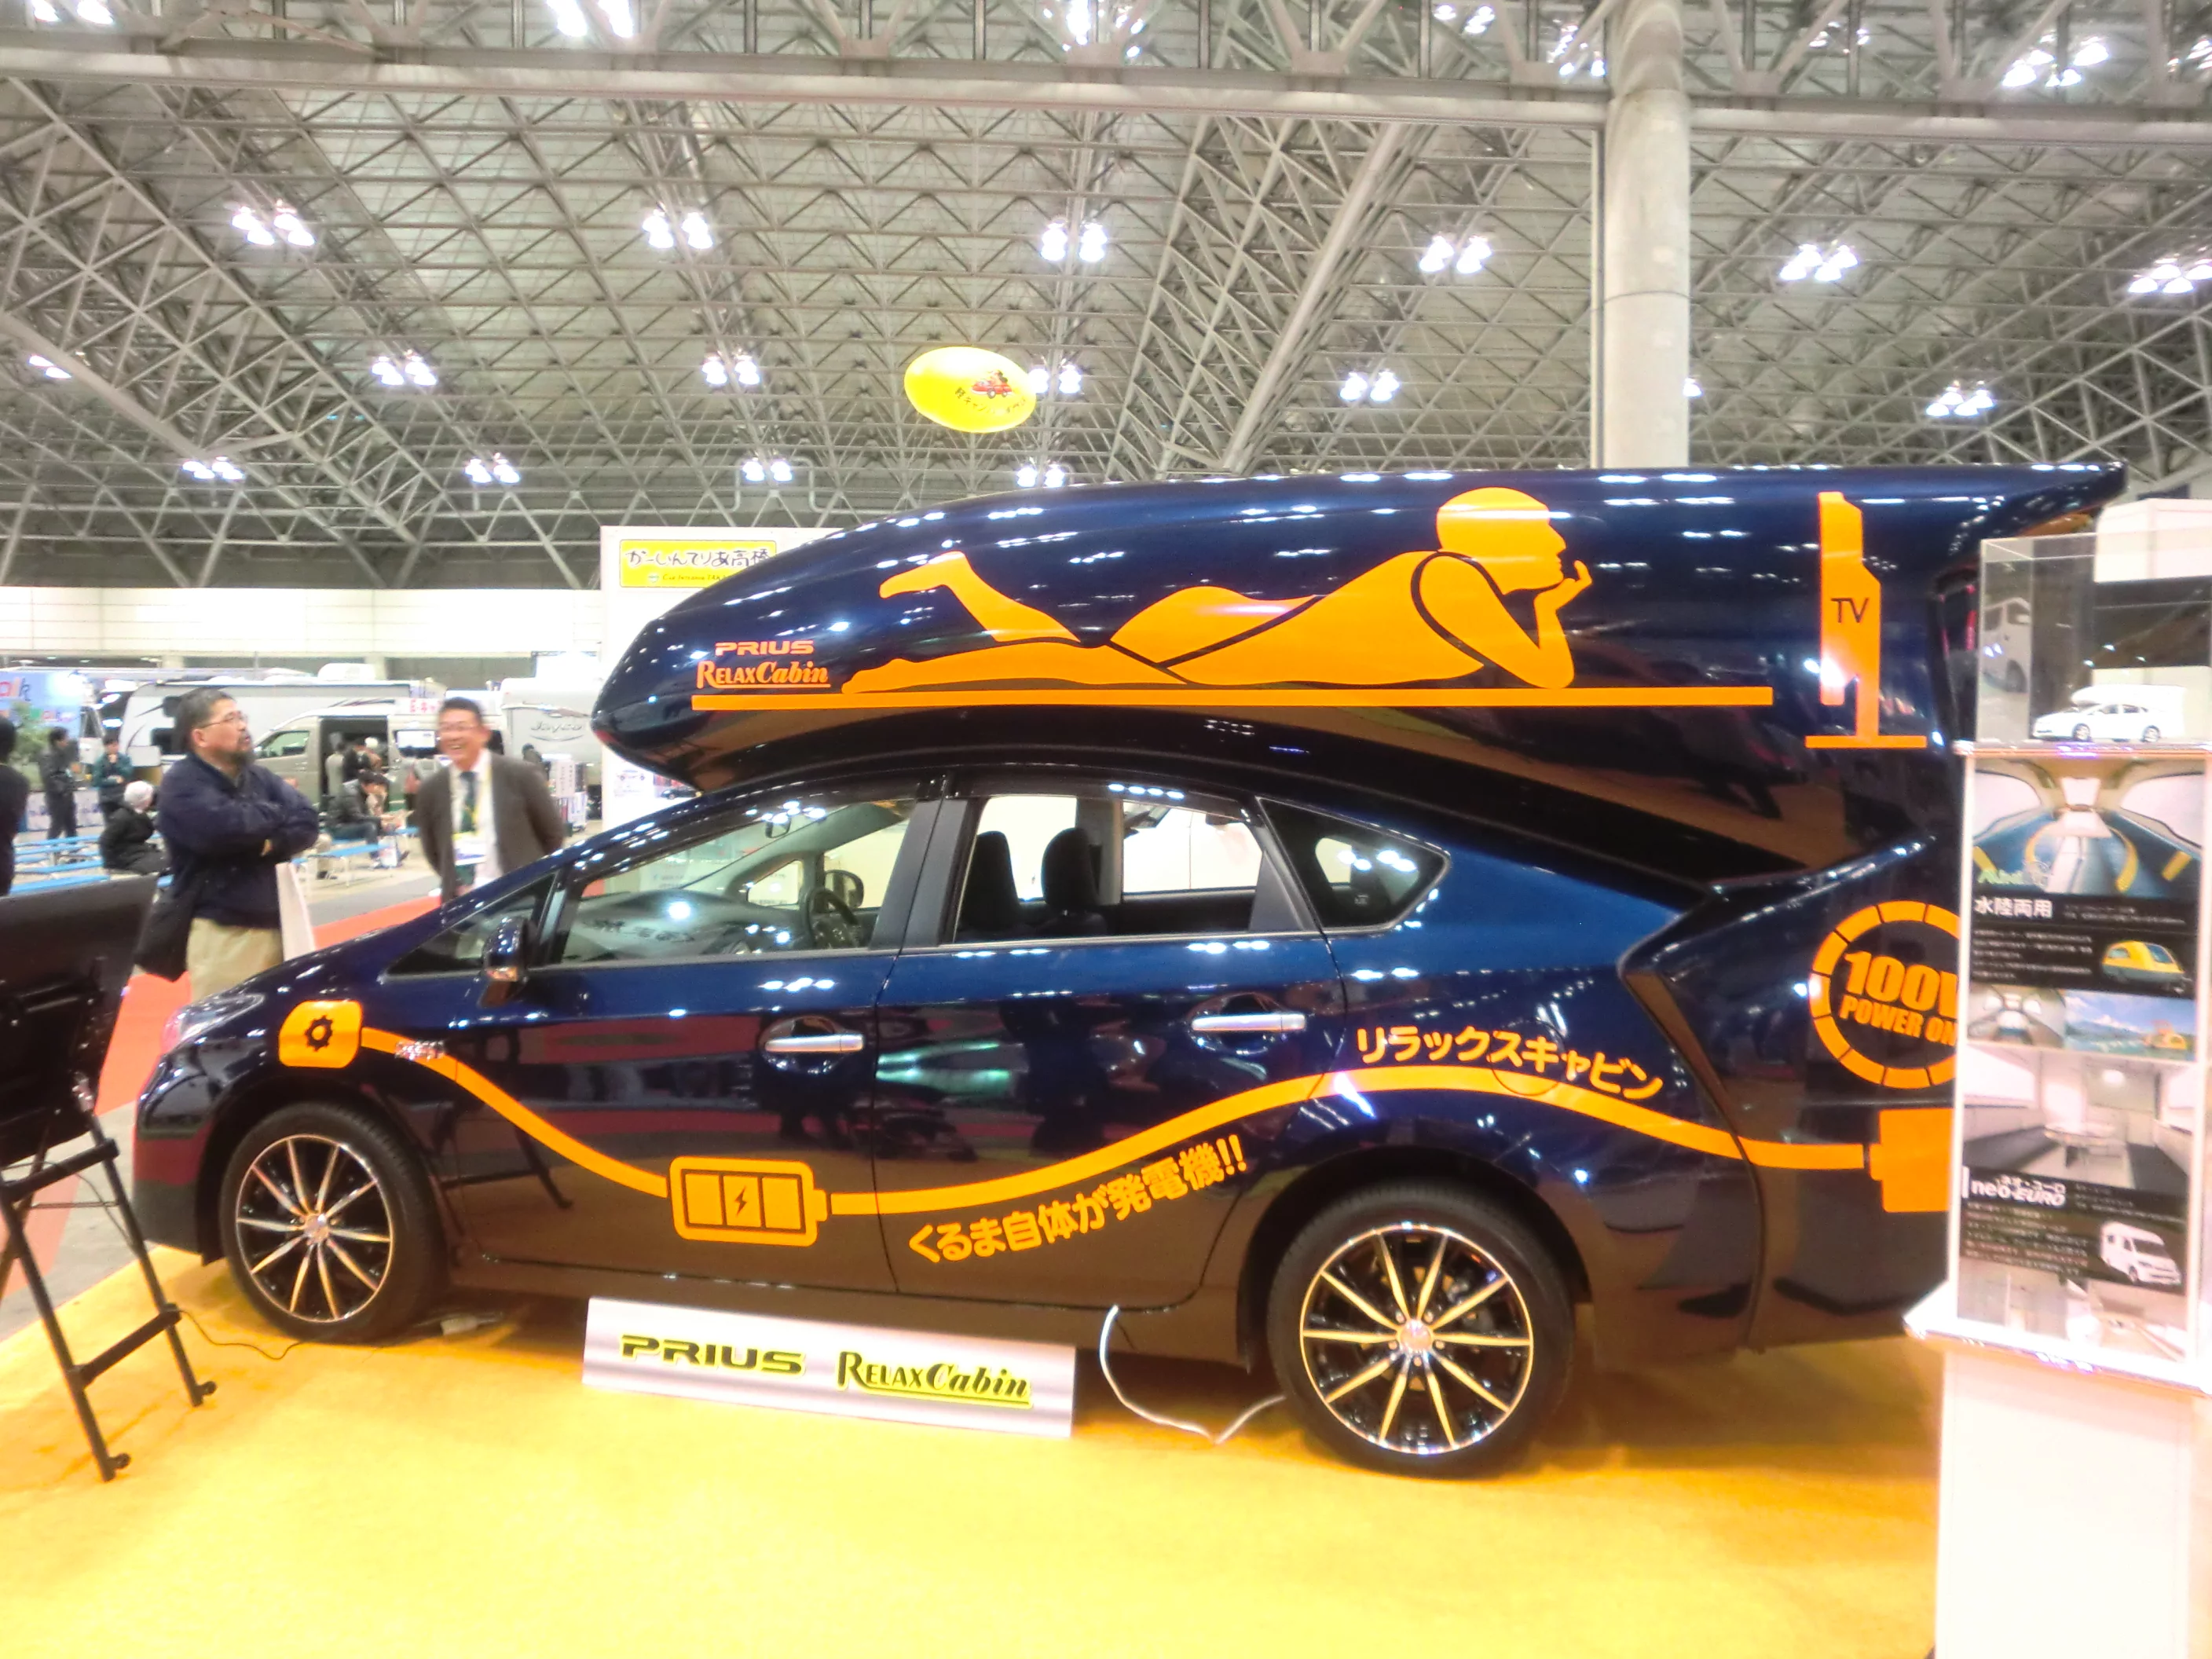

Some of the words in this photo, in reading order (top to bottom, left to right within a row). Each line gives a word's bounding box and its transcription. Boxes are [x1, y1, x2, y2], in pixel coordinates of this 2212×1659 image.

[1830, 598, 1869, 624] TV
[715, 640, 814, 656] PRIUS
[1974, 895, 2053, 918] 水陸両用
[1839, 994, 1924, 1038] POWER
[1357, 1025, 1664, 1100] リラックスキャビン
[621, 1335, 804, 1375] PRIUS
